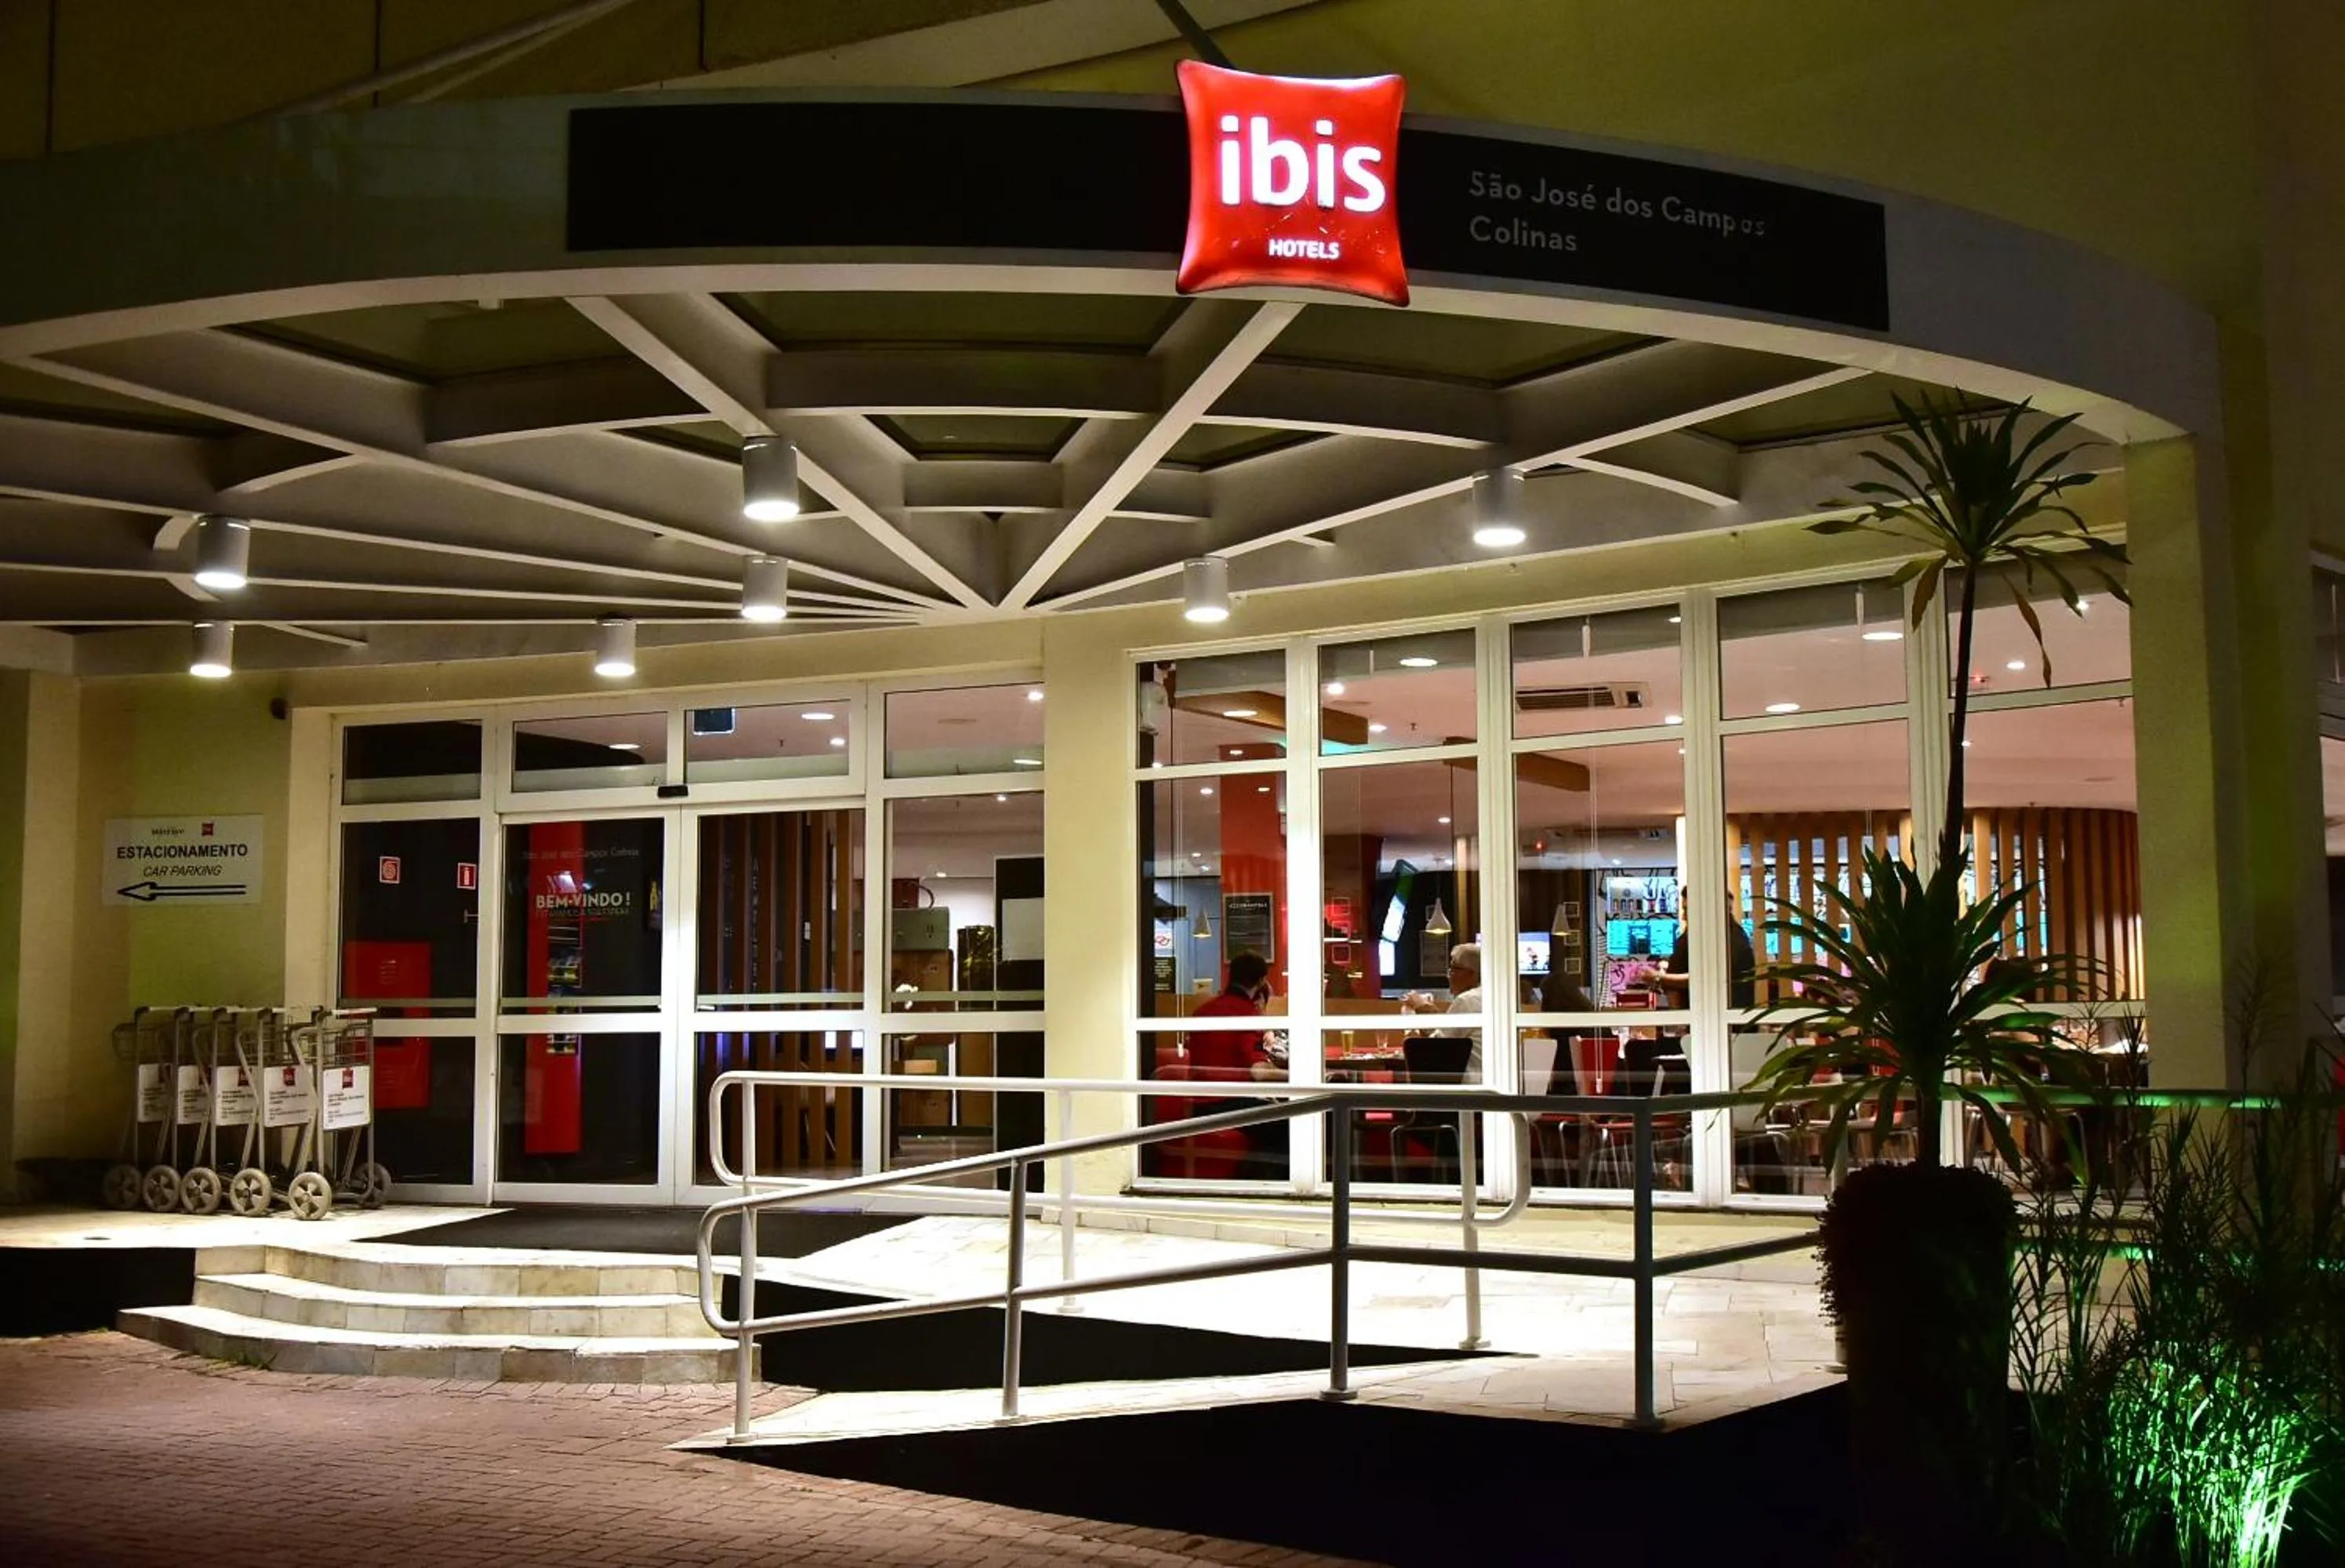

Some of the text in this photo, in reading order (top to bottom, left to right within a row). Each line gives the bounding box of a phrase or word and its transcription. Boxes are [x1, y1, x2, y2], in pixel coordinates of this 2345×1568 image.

[1219, 114, 1386, 212] ibis
[1468, 170, 1766, 238] São José dos Campos
[1469, 215, 1577, 252] Colinas
[1269, 238, 1339, 260] HOTELS
[117, 844, 248, 859] ESTACIONAMENTO
[143, 865, 223, 877] CAR PARKING
